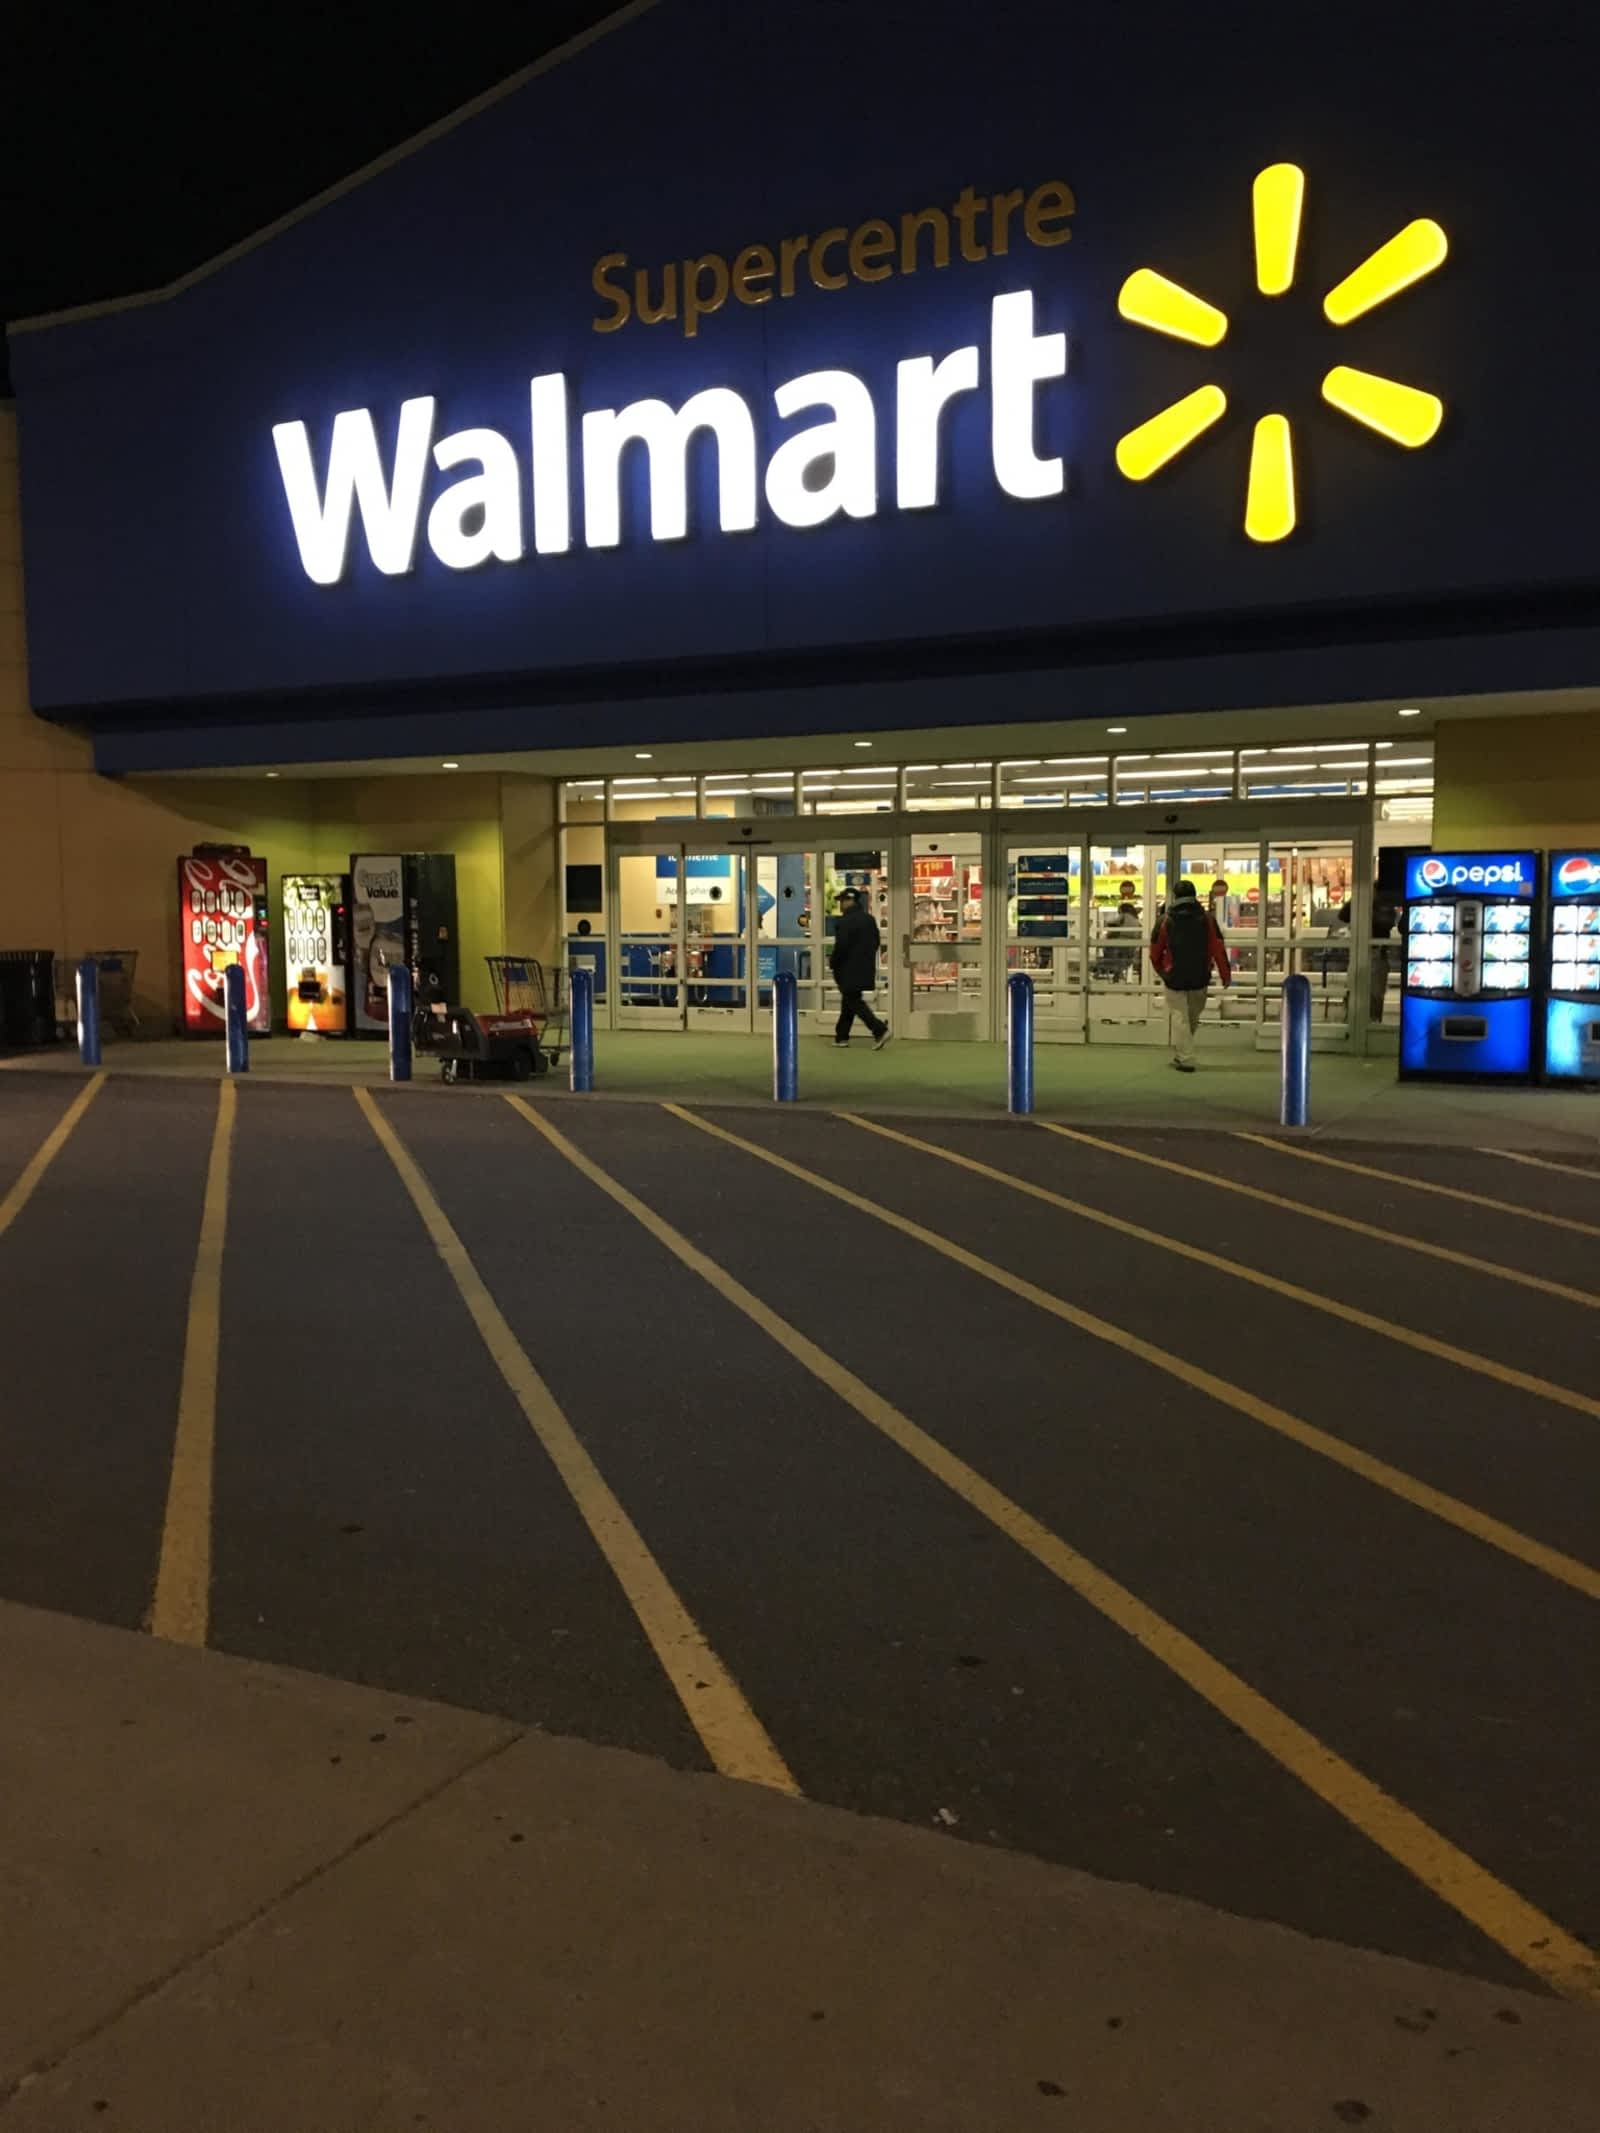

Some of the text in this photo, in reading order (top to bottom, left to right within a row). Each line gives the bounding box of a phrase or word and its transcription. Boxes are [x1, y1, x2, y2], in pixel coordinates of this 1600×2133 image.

[590, 181, 1077, 339] Supercentre
[271, 289, 1067, 586] Walmart
[366, 887, 399, 899] Value
[1452, 861, 1524, 887] pepsi
